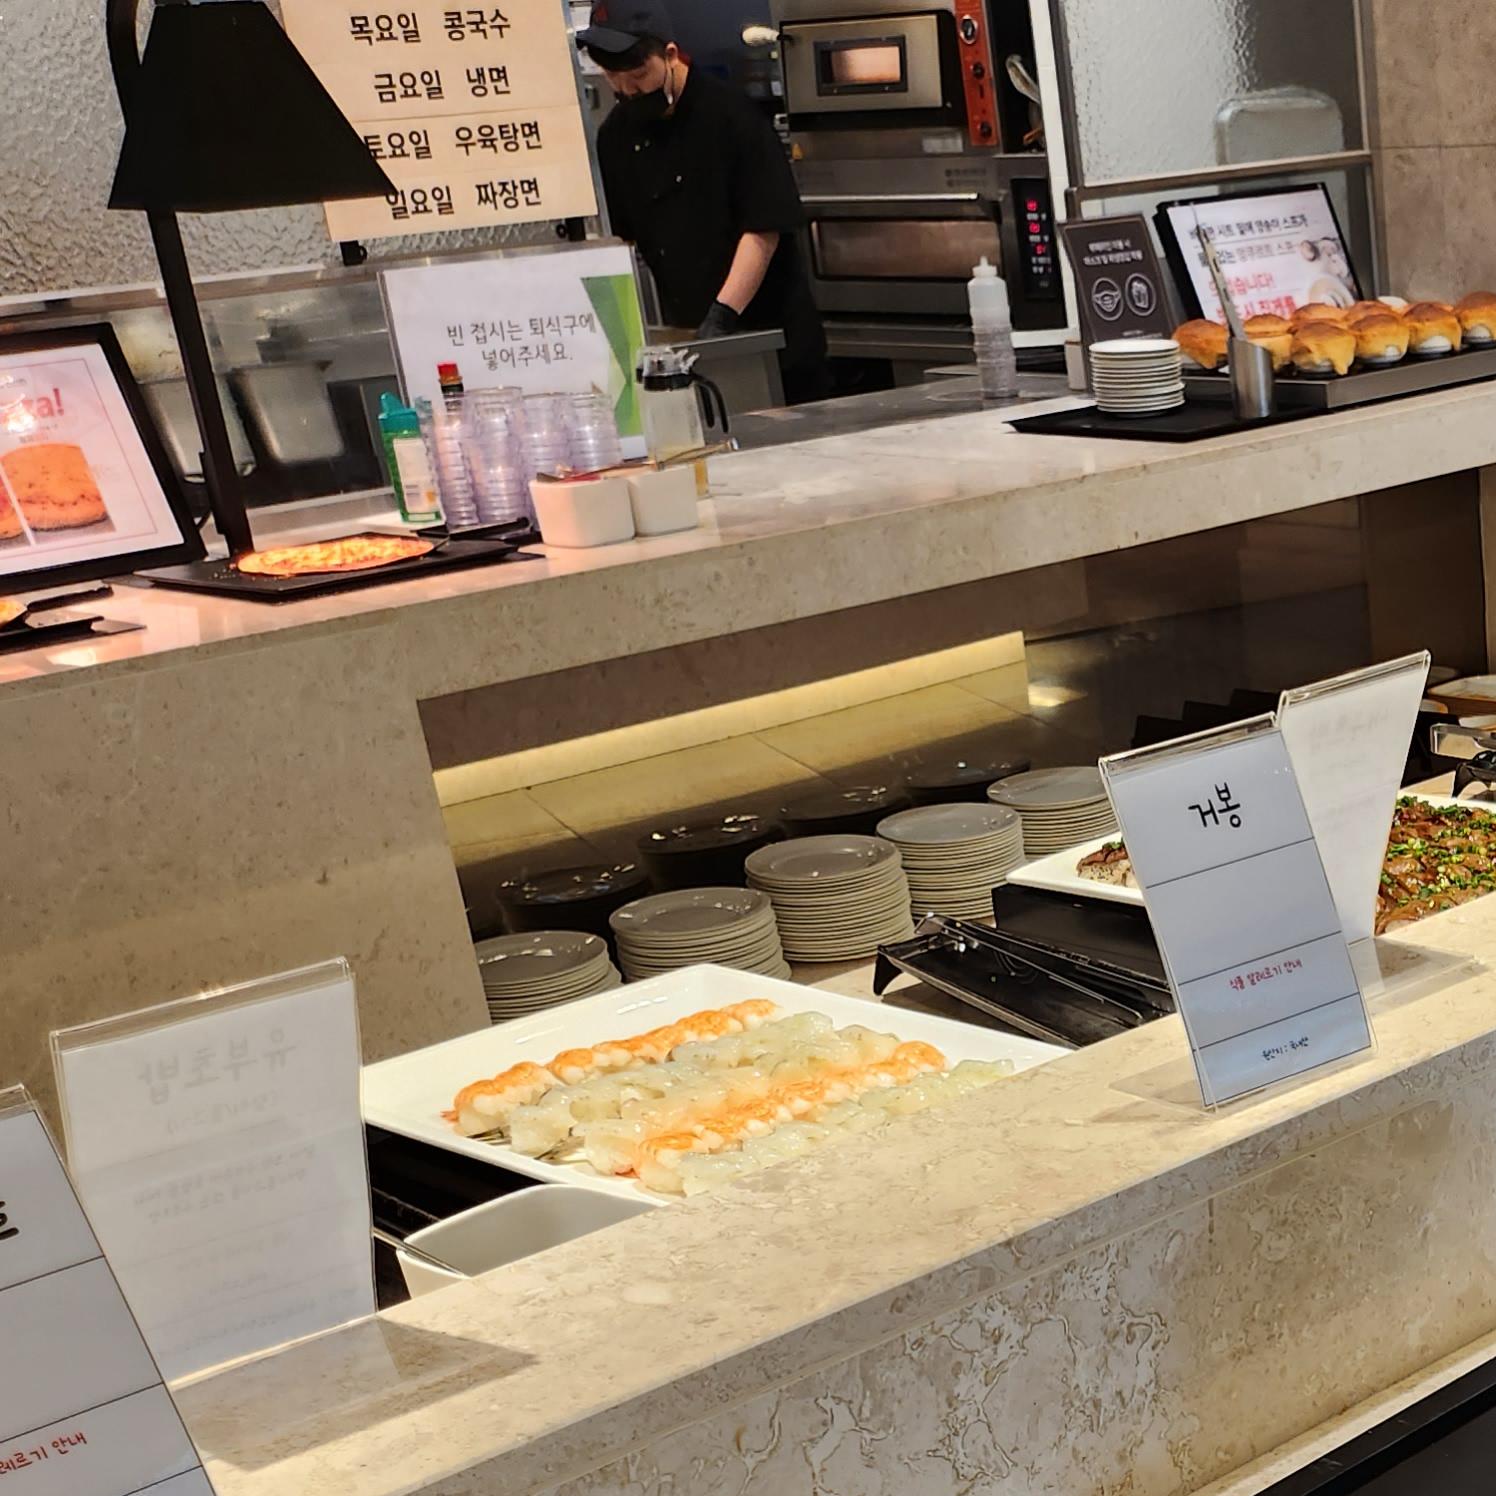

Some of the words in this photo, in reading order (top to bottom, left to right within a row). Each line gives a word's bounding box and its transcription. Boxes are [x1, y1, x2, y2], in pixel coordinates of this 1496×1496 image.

[350, 12, 421, 46] 목요일
[444, 9, 511, 42] 콩국수
[374, 69, 444, 104] 금요일
[466, 65, 511, 98] 냉면
[364, 129, 433, 161] 토요일
[455, 121, 543, 156] 우육탕면
[385, 186, 455, 221] 일요일
[475, 177, 542, 211] 짜장면
[446, 323, 464, 348] 빈
[470, 320, 524, 345] 접시는
[529, 312, 597, 339] 퇴식구에
[482, 342, 574, 372] 넣어주세요.
[1188, 781, 1241, 829] 거봉
[51, 1432, 87, 1455] 안내
